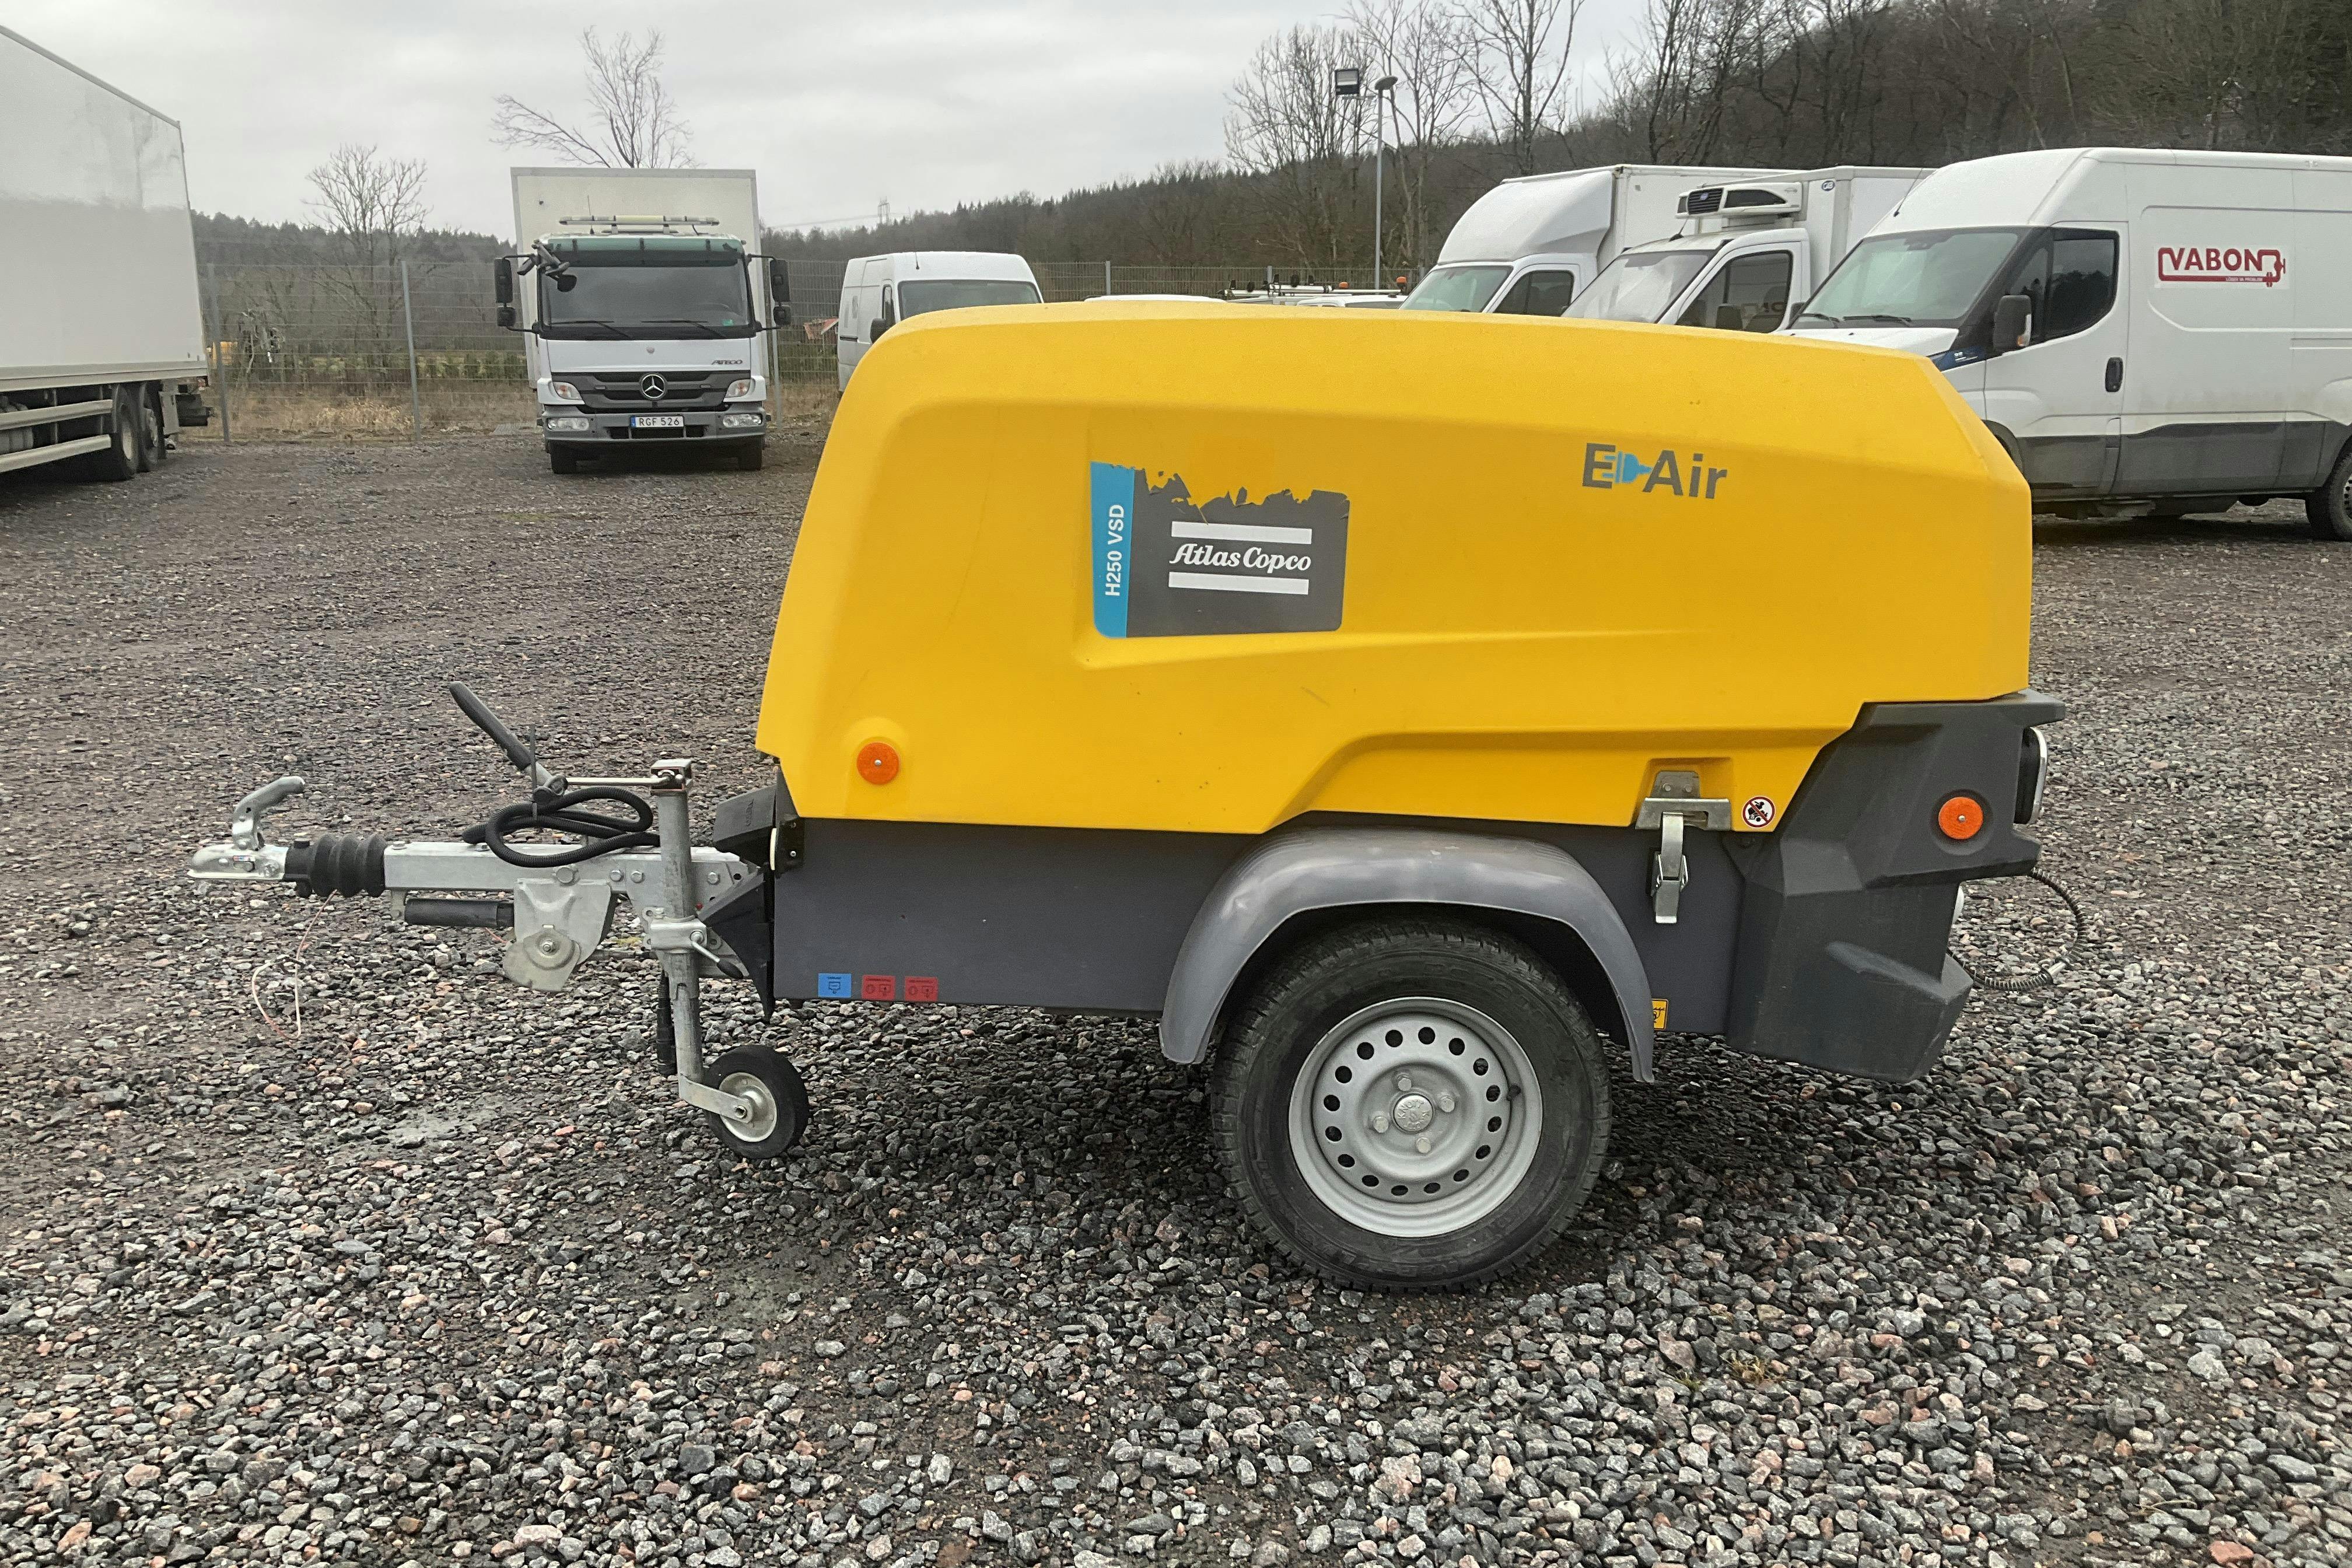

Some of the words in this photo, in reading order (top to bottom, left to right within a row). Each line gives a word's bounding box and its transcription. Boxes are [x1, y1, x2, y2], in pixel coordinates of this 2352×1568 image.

[2159, 247, 2263, 271] VABON
[639, 418, 657, 426] RGF
[660, 417, 680, 426] 526
[1107, 505, 1124, 545] VSD
[1105, 550, 1122, 596] H250
[1169, 543, 1241, 567] Atlas
[1243, 547, 1311, 573] Copco
